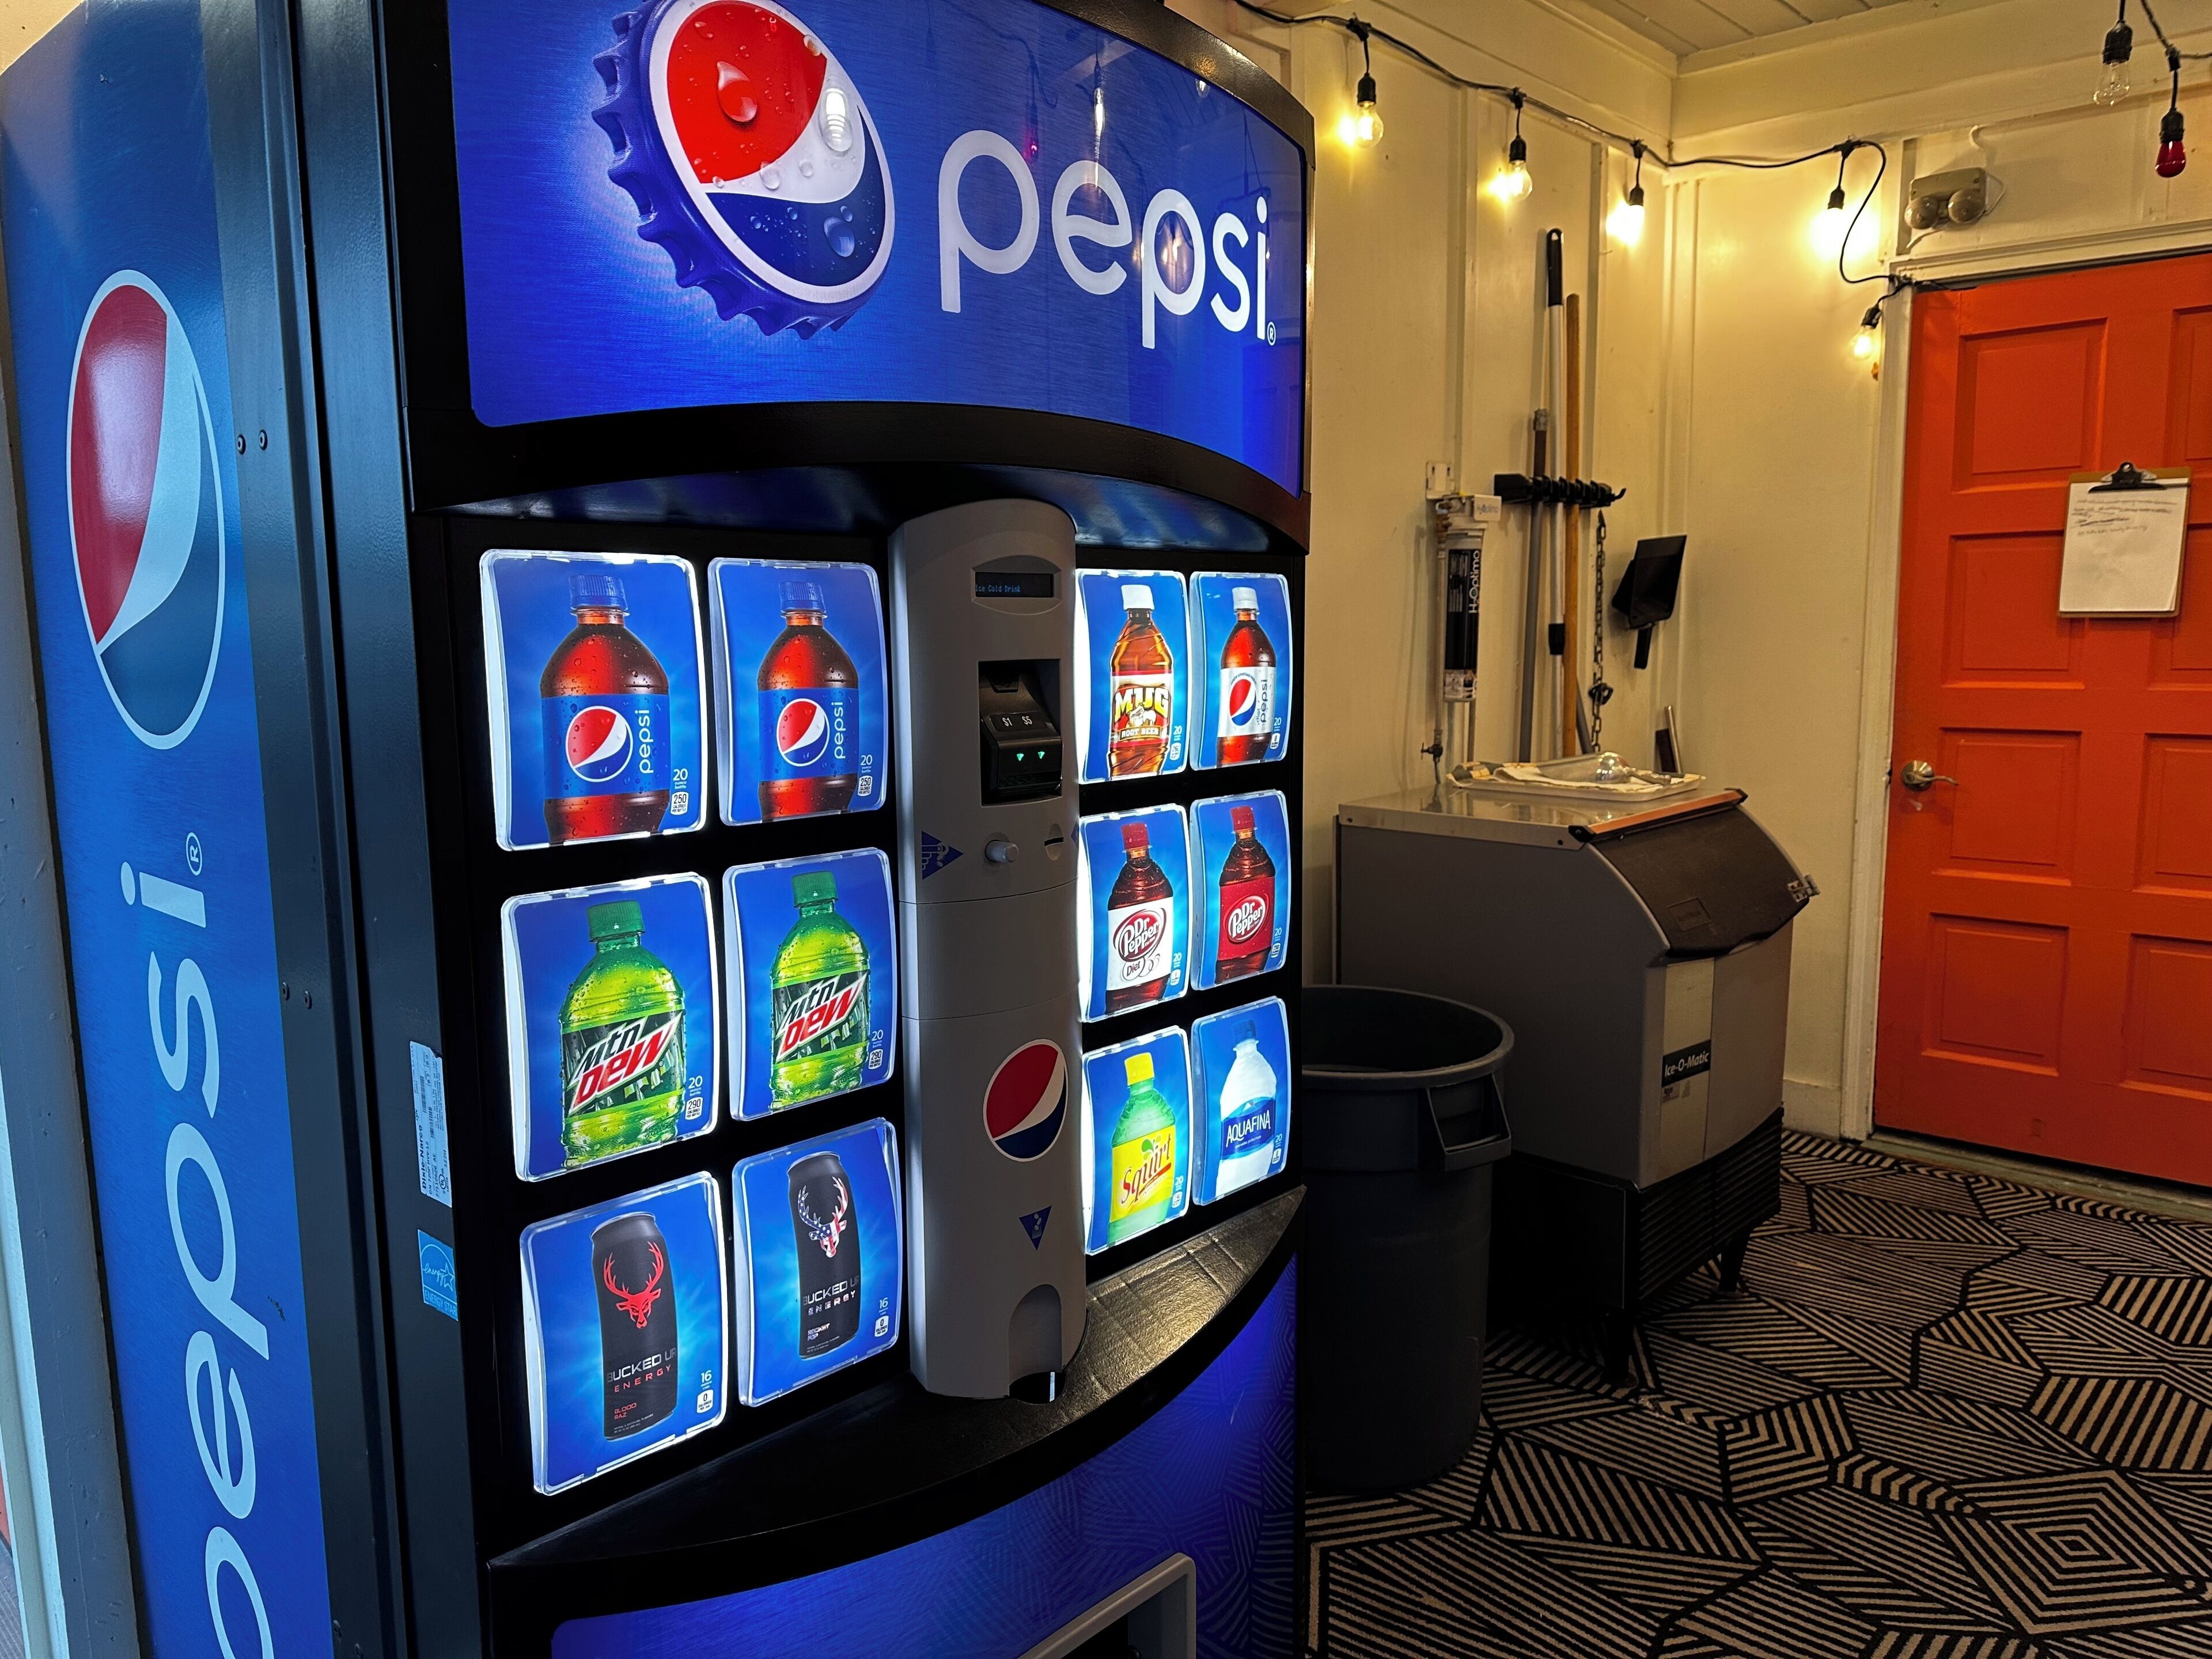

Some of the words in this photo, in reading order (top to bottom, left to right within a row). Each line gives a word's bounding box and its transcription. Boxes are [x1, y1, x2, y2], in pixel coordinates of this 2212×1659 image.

[938, 130, 1267, 349] pepsi
[1115, 687, 1169, 723] MUG
[1002, 717, 1012, 727] $1
[1022, 715, 1032, 725] $5
[1274, 717, 1282, 726] 20
[831, 702, 846, 759] pepsi
[1121, 729, 1139, 738] ROOT
[1141, 728, 1159, 736] BEER
[1173, 725, 1183, 735] 20
[635, 710, 654, 774] pepsi
[861, 755, 873, 766] 20
[673, 768, 688, 781] 20
[861, 777, 871, 786] 250
[673, 793, 687, 804] 250
[1242, 902, 1255, 920] Dr
[1134, 917, 1150, 937] Dr
[1231, 906, 1263, 938] Pepper
[1275, 927, 1282, 936] 20
[1123, 921, 1160, 957] Pepper
[1173, 952, 1182, 963] 20
[1127, 961, 1141, 976] Diet
[872, 1029, 883, 1041] 20
[871, 1050, 881, 1060] 290
[1665, 1051, 1709, 1077] Ice-O-Matic
[688, 1075, 703, 1089] 20
[688, 1099, 701, 1110] 290
[1226, 1109, 1271, 1147] AQUAFINA
[1275, 1134, 1282, 1143] 20
[419, 1124, 427, 1190] Dixie-Narco
[1121, 1133, 1171, 1204] Squirt
[1175, 1176, 1184, 1184] 20
[802, 1281, 847, 1306] BUCKED
[425, 1290, 444, 1309] ENERGY
[444, 1301, 457, 1316] STAR
[808, 1290, 855, 1316] ENERGY
[879, 1297, 888, 1309] 16
[880, 1319, 884, 1327] 0
[607, 1354, 662, 1383] BUCKED
[614, 1364, 671, 1393] ENERGY
[701, 1370, 712, 1382] 16
[703, 1393, 707, 1402] 0
[614, 1402, 637, 1414] BLOOD
[614, 1412, 627, 1420] RAZ
